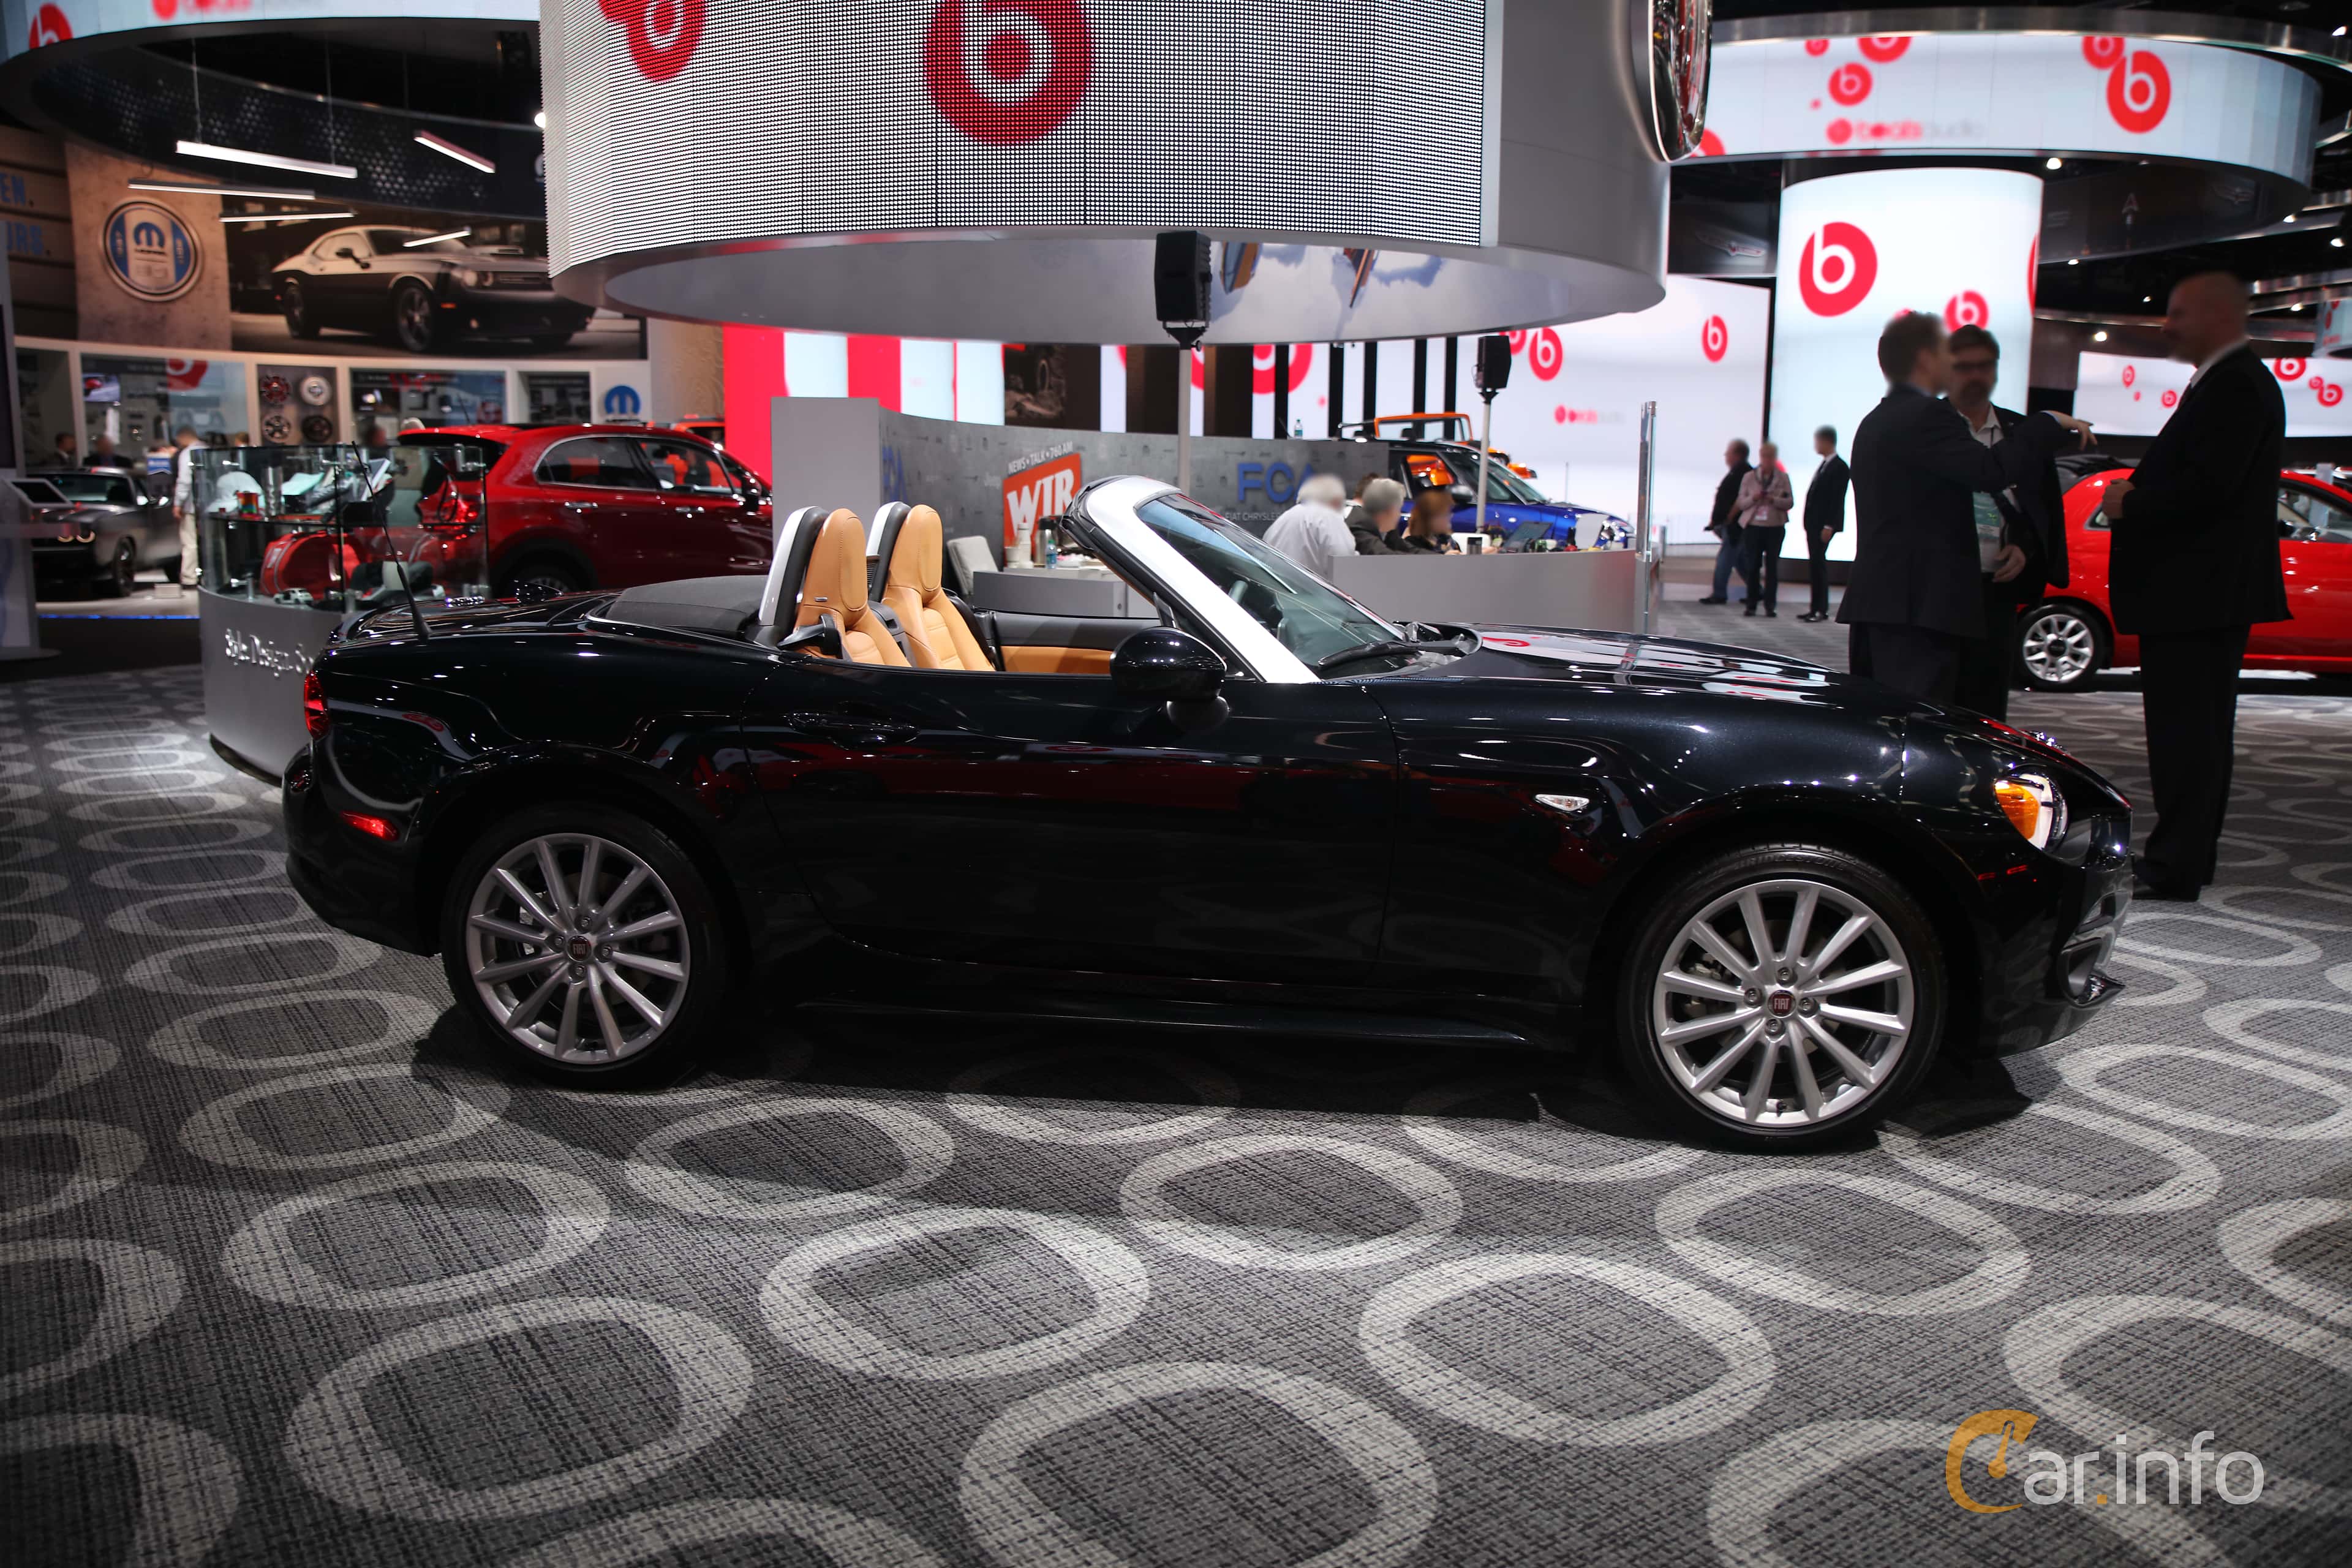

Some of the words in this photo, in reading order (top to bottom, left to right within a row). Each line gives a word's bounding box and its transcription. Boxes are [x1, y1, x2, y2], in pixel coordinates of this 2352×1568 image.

[1008, 456, 1027, 475] NEWS
[1030, 450, 1046, 466] TALK
[1774, 998, 1790, 1010] FIAT
